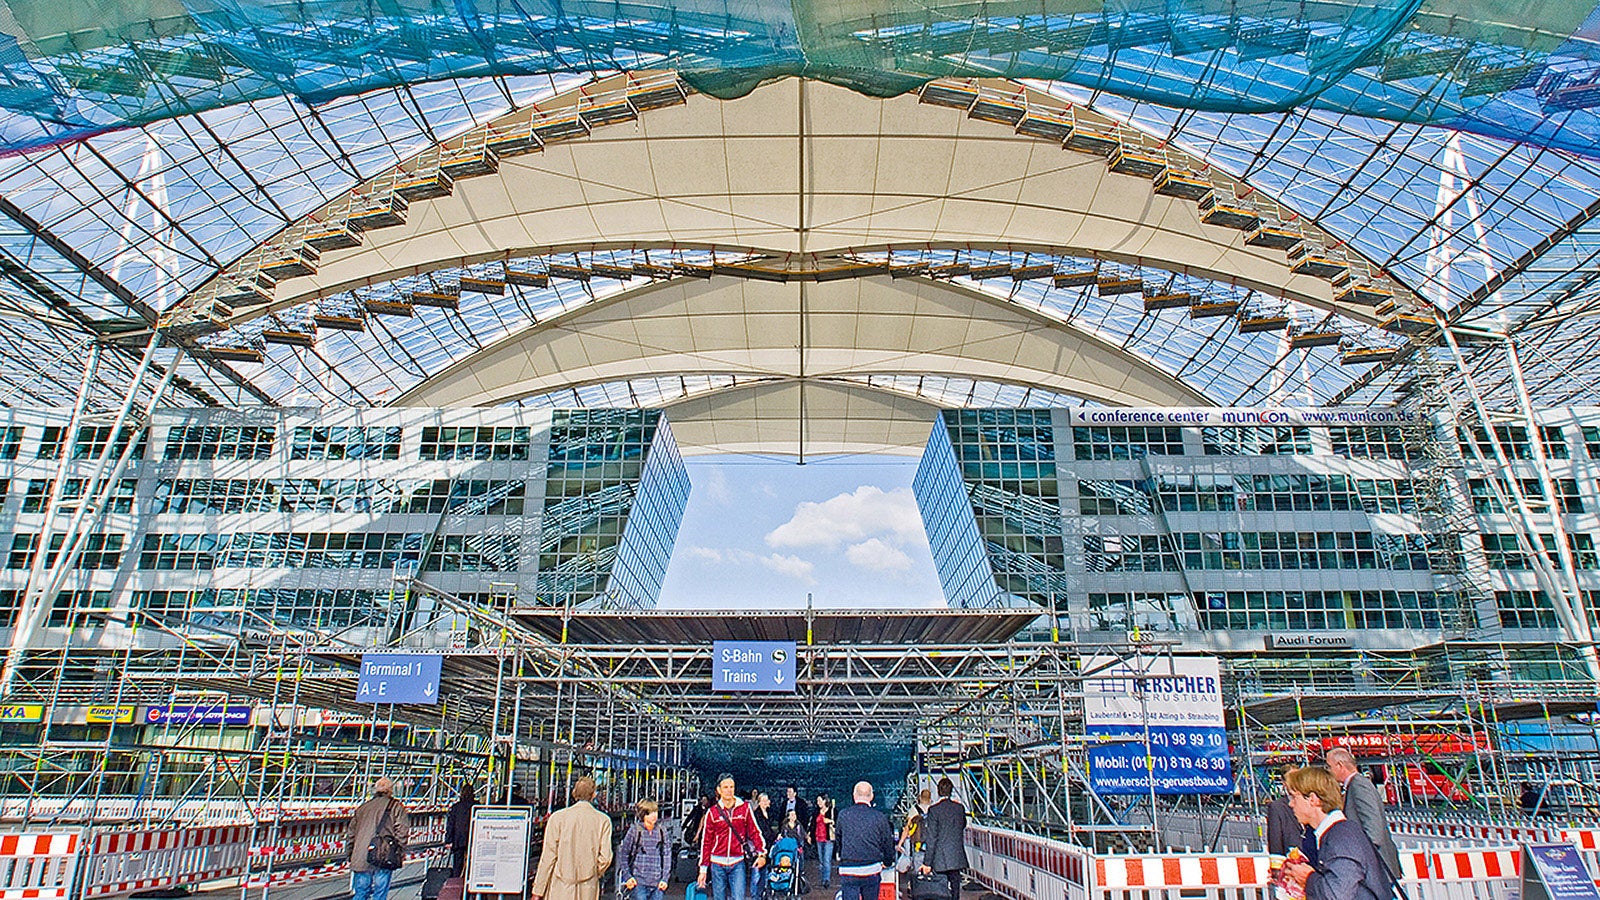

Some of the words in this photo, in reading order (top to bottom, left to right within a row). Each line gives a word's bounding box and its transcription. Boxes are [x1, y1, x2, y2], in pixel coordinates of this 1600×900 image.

[1091, 410, 1164, 422] conference
[1168, 411, 1209, 422] center
[1301, 410, 1414, 422] www.municon.de
[1277, 635, 1305, 645] Audi
[1308, 635, 1347, 645] Forum
[722, 649, 762, 663] S-Bahn
[364, 661, 412, 676] Terminal
[416, 662, 422, 676] 1
[722, 669, 757, 683] Trains
[1133, 677, 1216, 693] KERSCHER
[0, 706, 26, 718] KA
[1151, 732, 1169, 747] 21)
[1171, 733, 1186, 746] 98
[1190, 733, 1204, 746] 99
[1208, 734, 1222, 746] 10
[1095, 755, 1129, 769] Mobil:
[1194, 757, 1209, 770] 48
[1211, 758, 1226, 770] 30
